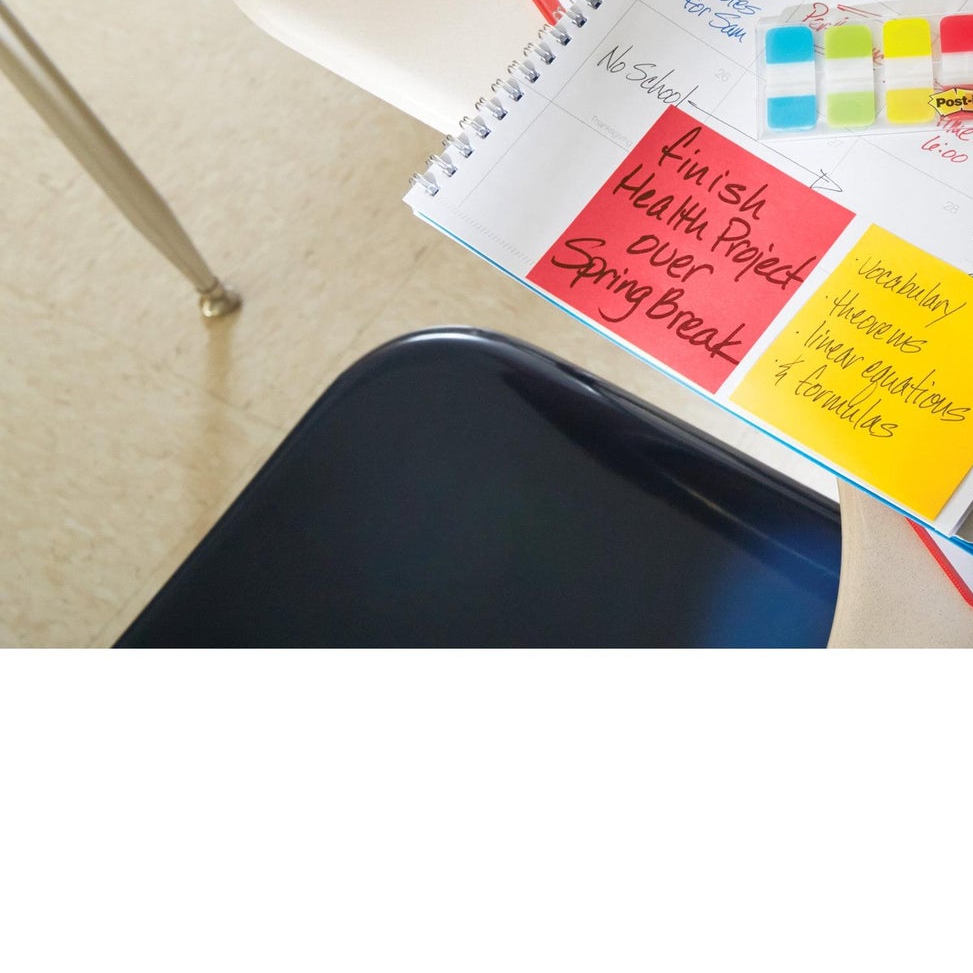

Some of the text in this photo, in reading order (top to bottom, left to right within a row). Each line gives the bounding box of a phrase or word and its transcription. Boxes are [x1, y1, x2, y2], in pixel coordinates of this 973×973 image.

[708, 12, 747, 43] Sam
[597, 45, 699, 107] No School
[658, 125, 769, 220] finish
[921, 135, 969, 164] 6:00
[612, 164, 817, 290] Health Project
[626, 234, 714, 282] over
[551, 238, 746, 365] Spring Break
[827, 289, 928, 355] theorems
[856, 255, 967, 327] vocabulary
[794, 364, 899, 438] formulas
[804, 320, 971, 423] linear equations
